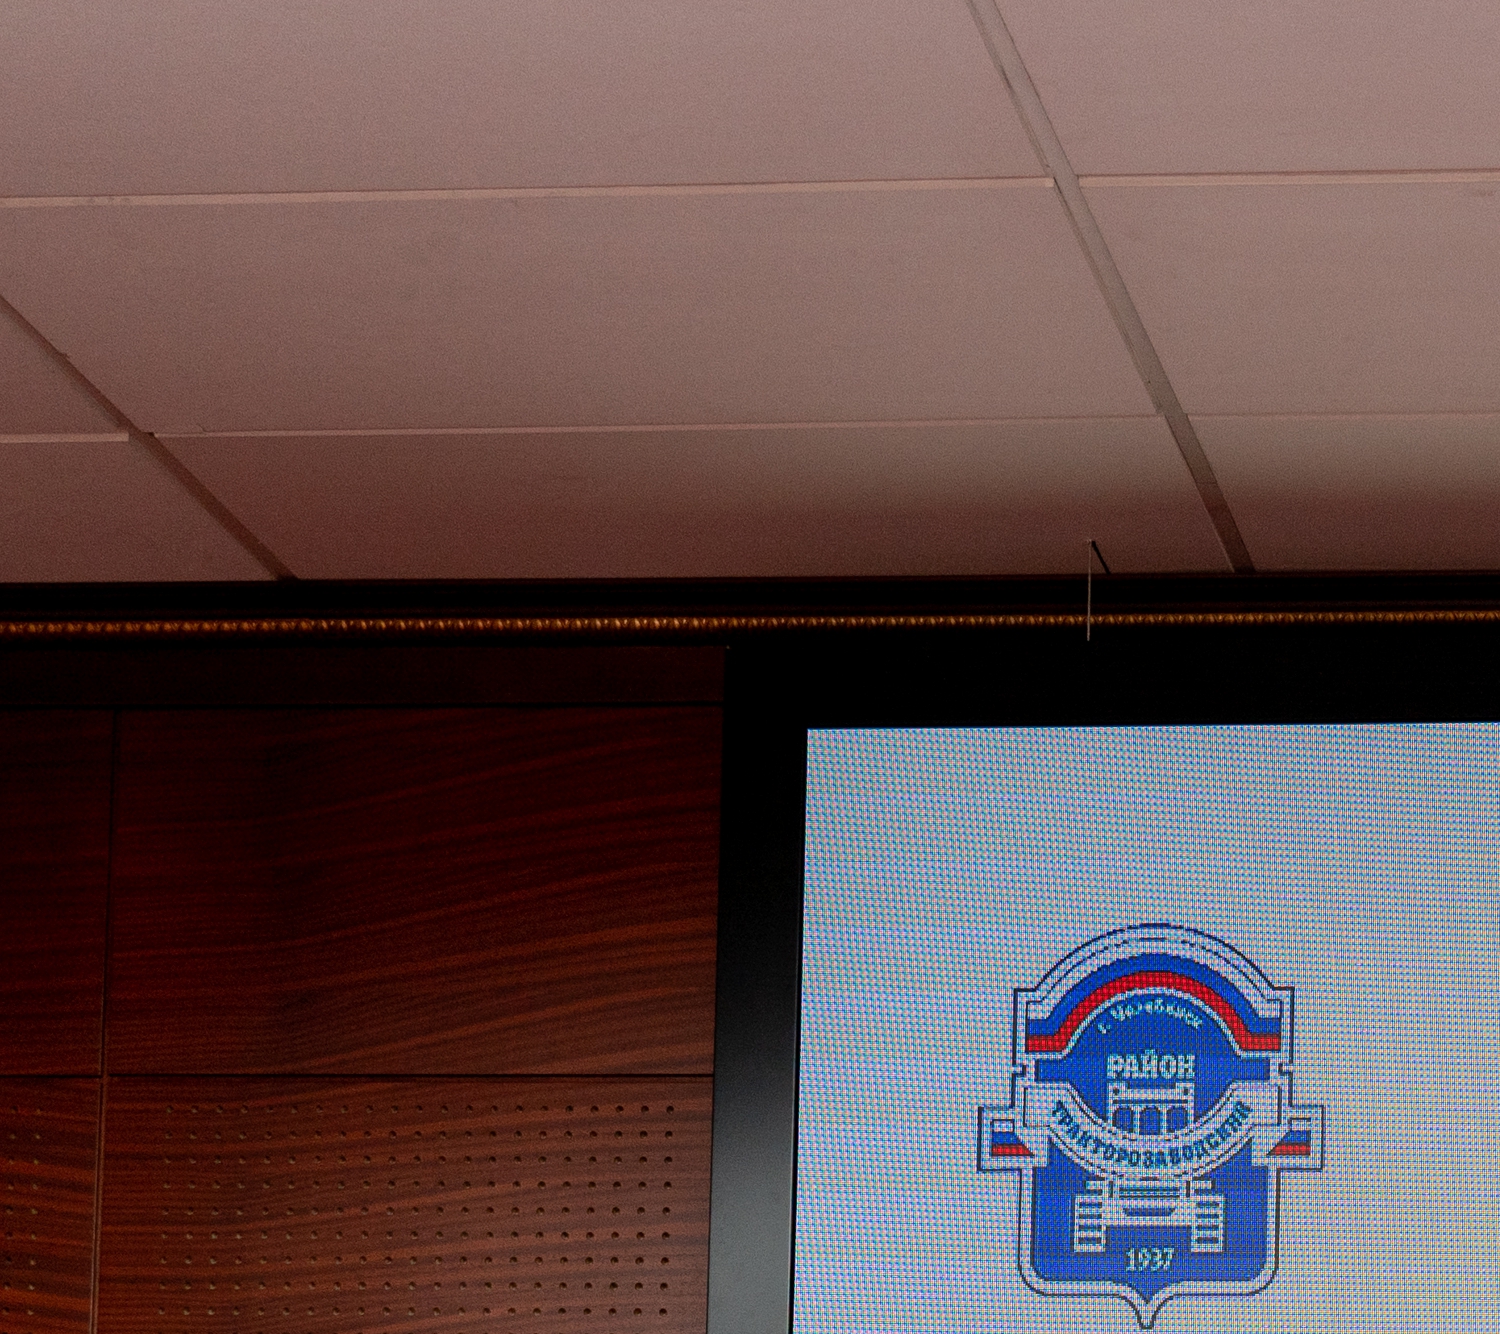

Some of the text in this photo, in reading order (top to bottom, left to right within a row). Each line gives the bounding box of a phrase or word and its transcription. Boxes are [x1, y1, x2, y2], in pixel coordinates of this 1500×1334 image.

[1106, 1049, 1196, 1080] РАЙОН
[1051, 1099, 1253, 1169] ТРАКТОРОЗАВОДСКИЙ
[1124, 1246, 1176, 1272] 1937
